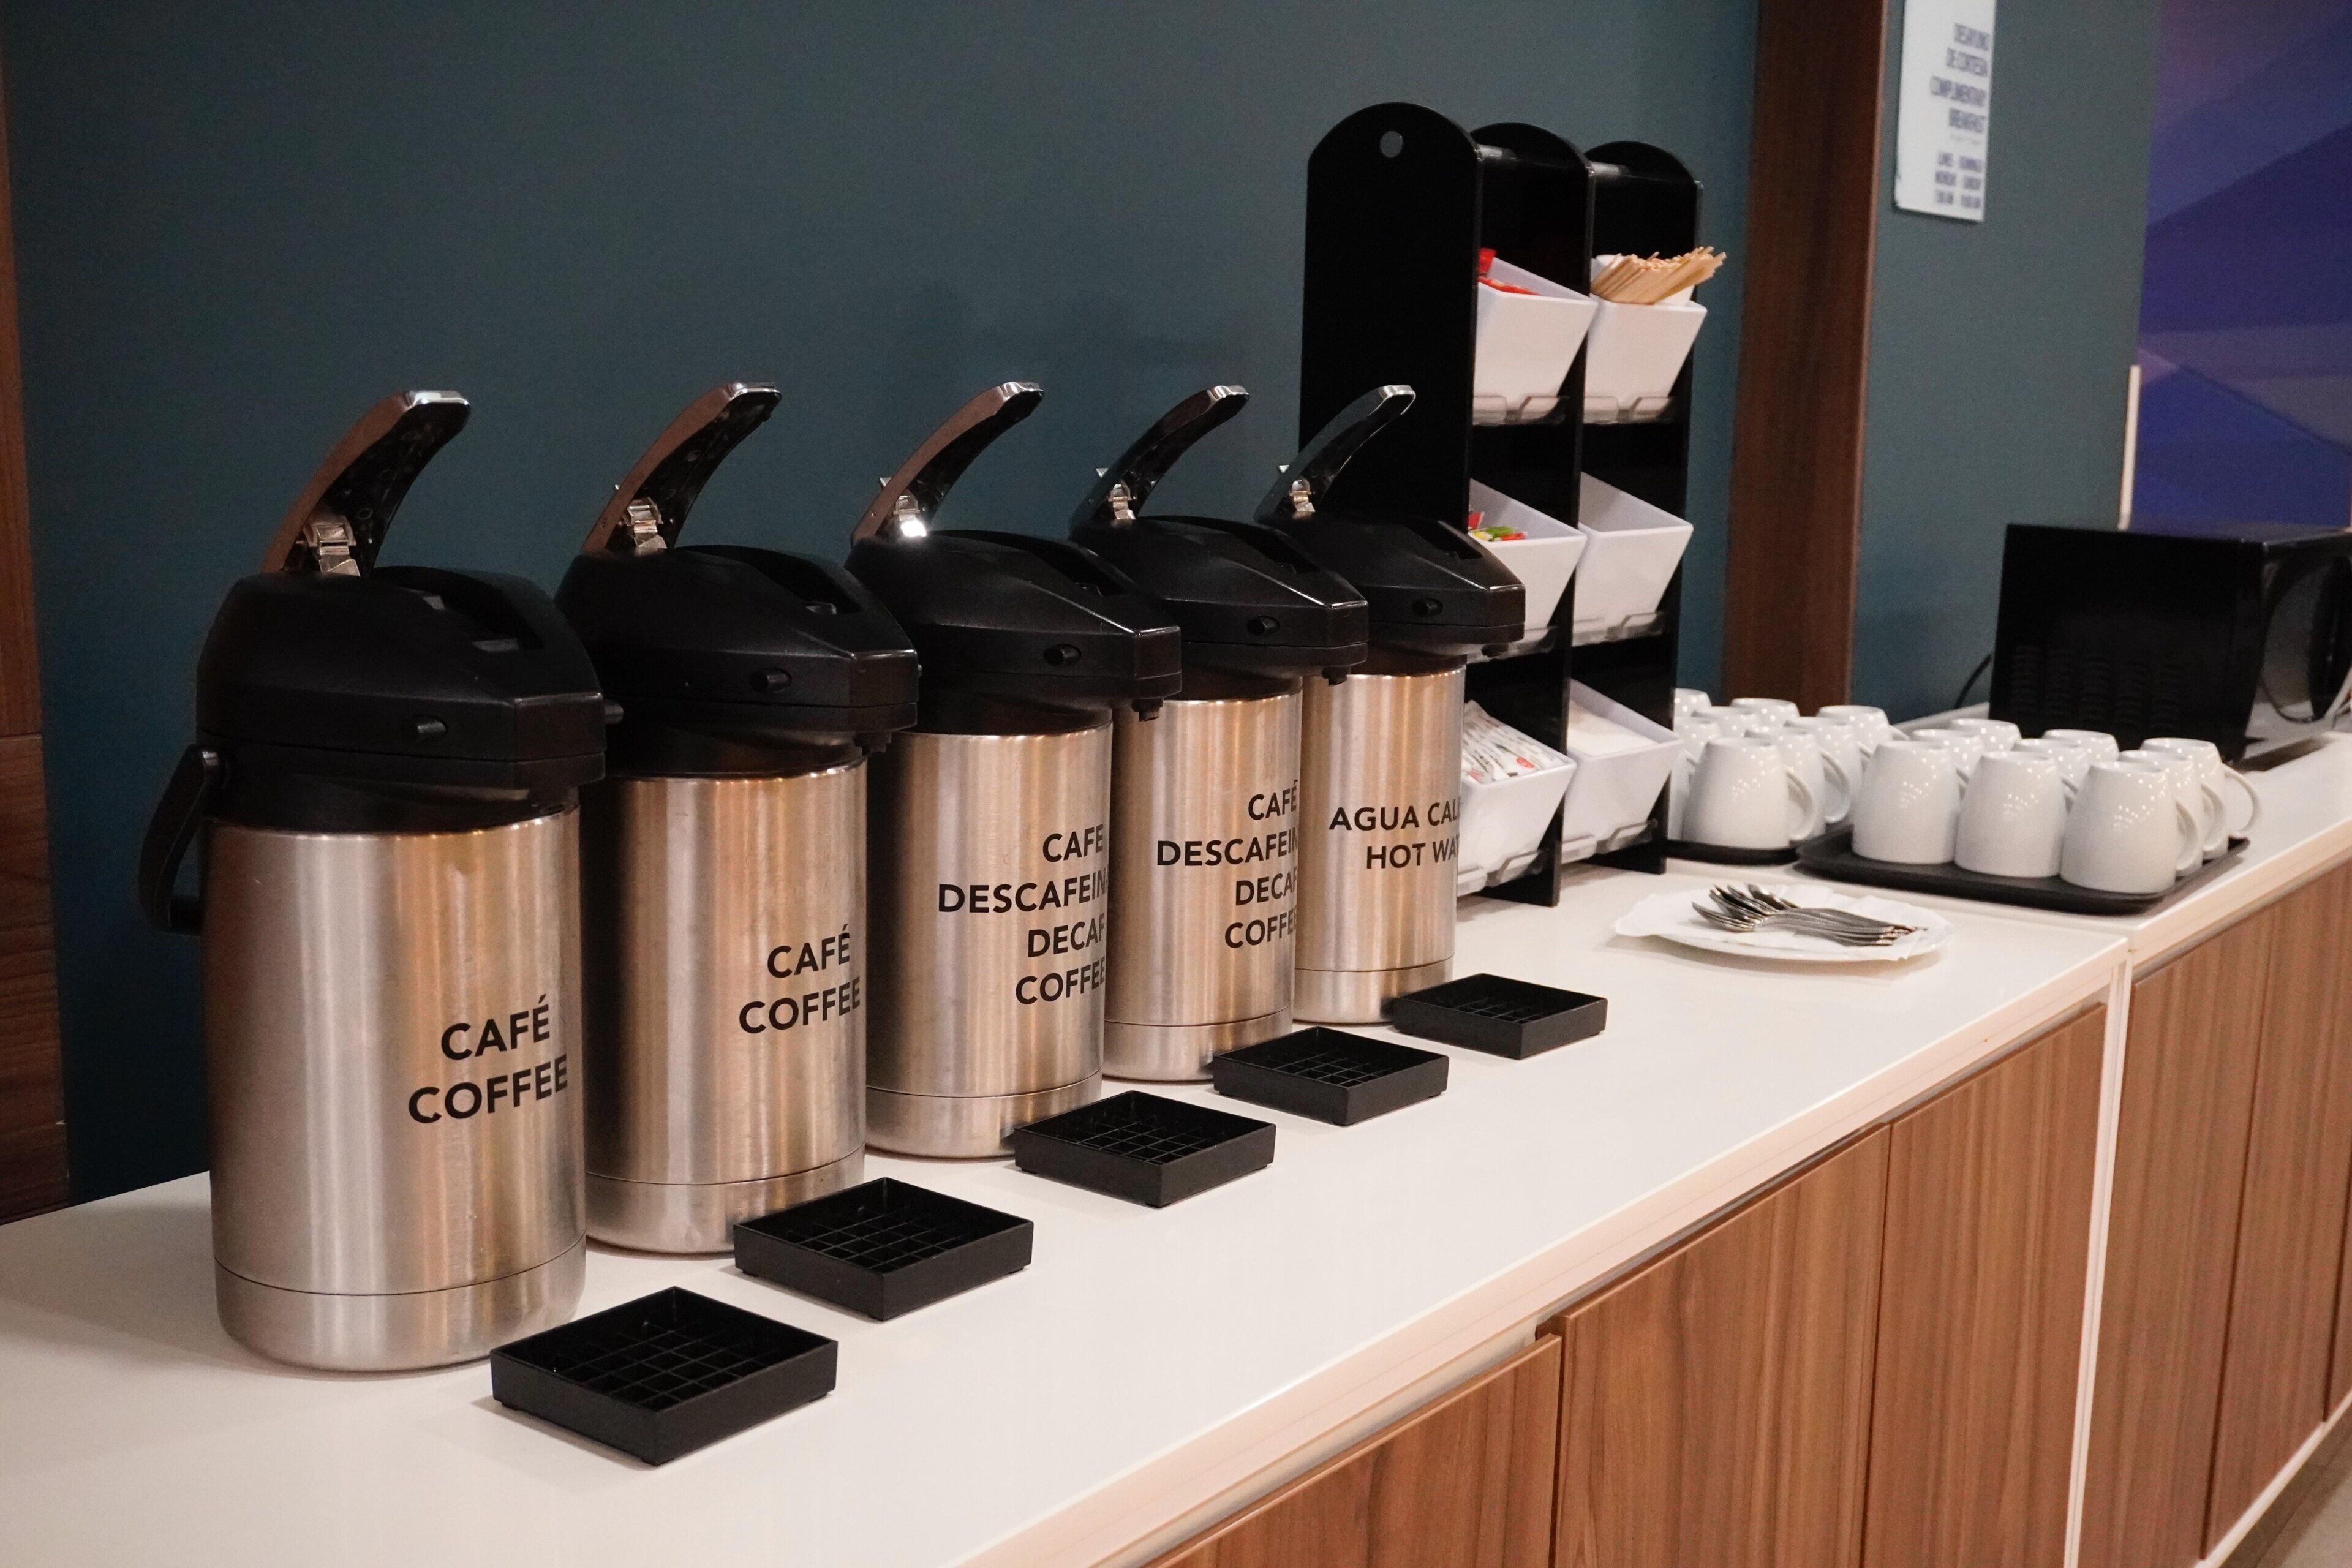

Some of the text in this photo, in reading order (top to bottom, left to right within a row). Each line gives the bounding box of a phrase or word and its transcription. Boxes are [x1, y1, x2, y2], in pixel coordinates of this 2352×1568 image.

[1248, 779, 1298, 820] CAFÉ
[1329, 805, 1420, 831] AGUA
[1042, 824, 1104, 862] CAFE
[1366, 842, 1426, 869] HOT
[1235, 866, 1297, 906] DECAF
[767, 924, 850, 978] CAFÉ
[1028, 912, 1105, 957] DECAF
[1016, 956, 1105, 1005] COFFEE
[441, 993, 550, 1060] CAFÉ
[739, 976, 860, 1033] COFFEE
[409, 1054, 568, 1123] COFFEE
